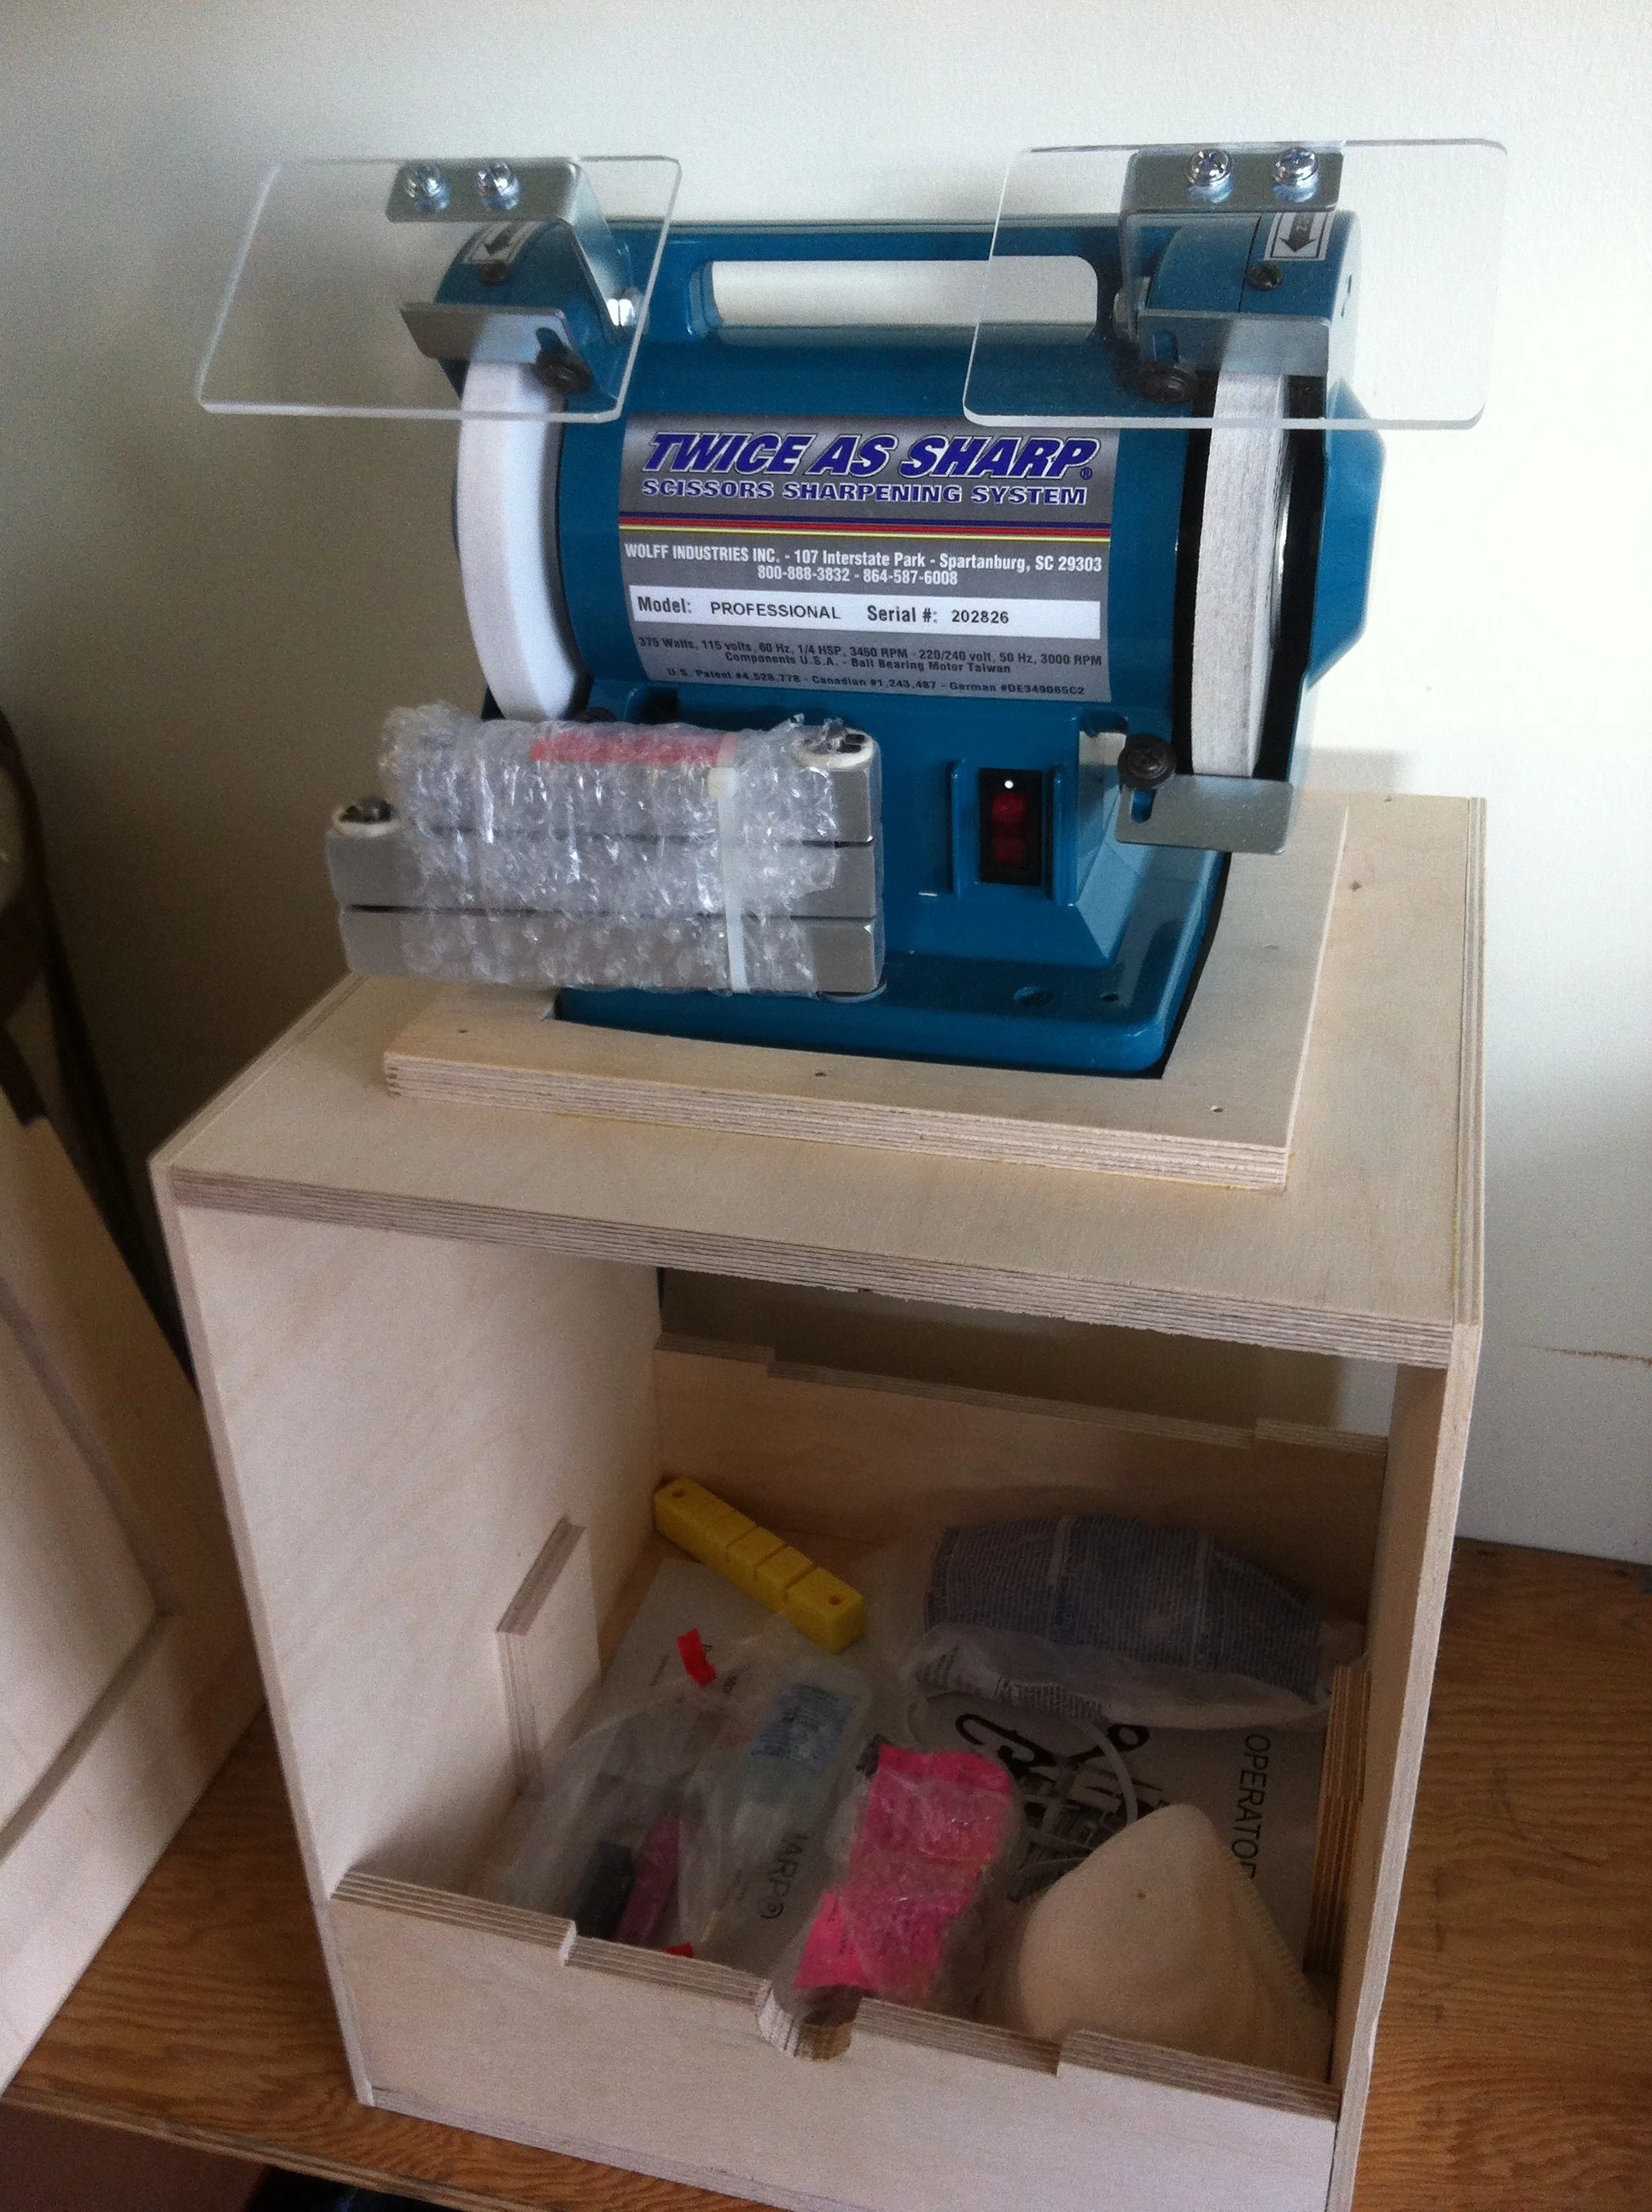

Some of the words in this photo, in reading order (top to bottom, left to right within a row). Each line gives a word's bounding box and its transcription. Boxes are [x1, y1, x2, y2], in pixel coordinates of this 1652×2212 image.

[643, 432, 816, 474] TWICE
[805, 434, 899, 478] AS
[643, 479, 774, 499] SCISSORS
[782, 482, 962, 503] SHARPENING
[971, 486, 1087, 505] SYSTEM
[625, 544, 668, 559] WOLFF
[672, 545, 748, 562] INDUSTRIES
[753, 548, 780, 563] INC.
[794, 550, 818, 564] 107
[823, 550, 889, 566] Interstate
[893, 552, 925, 568] Park
[939, 553, 1030, 573] Spartanburg,
[1035, 556, 1054, 570] SC
[1058, 556, 1102, 572] 29303
[758, 565, 850, 582] 800-888-3832
[863, 568, 957, 585] 864-587-6008
[638, 597, 692, 614] Model:
[711, 602, 841, 620] PROFESSIONAL
[867, 605, 916, 622] Serial
[951, 609, 1009, 624] 202826
[639, 637, 659, 648] 375
[701, 640, 722, 650] 115
[759, 643, 772, 653] 60
[798, 644, 814, 655] 1/4
[881, 648, 908, 659] RPM
[919, 649, 966, 661] 220/240
[969, 651, 996, 663] volt,
[1000, 653, 1014, 662] 50
[1018, 653, 1037, 665] Hz,
[1040, 654, 1070, 665] 3000
[1074, 655, 1102, 667] RPM
[725, 652, 795, 665] Components
[851, 658, 874, 668] Ball
[879, 660, 924, 672] Bearing
[928, 661, 963, 672] Motor
[968, 662, 1011, 673] Taiwan
[695, 670, 731, 679] Patent
[811, 675, 866, 686] Canadian
[950, 682, 997, 692] German
